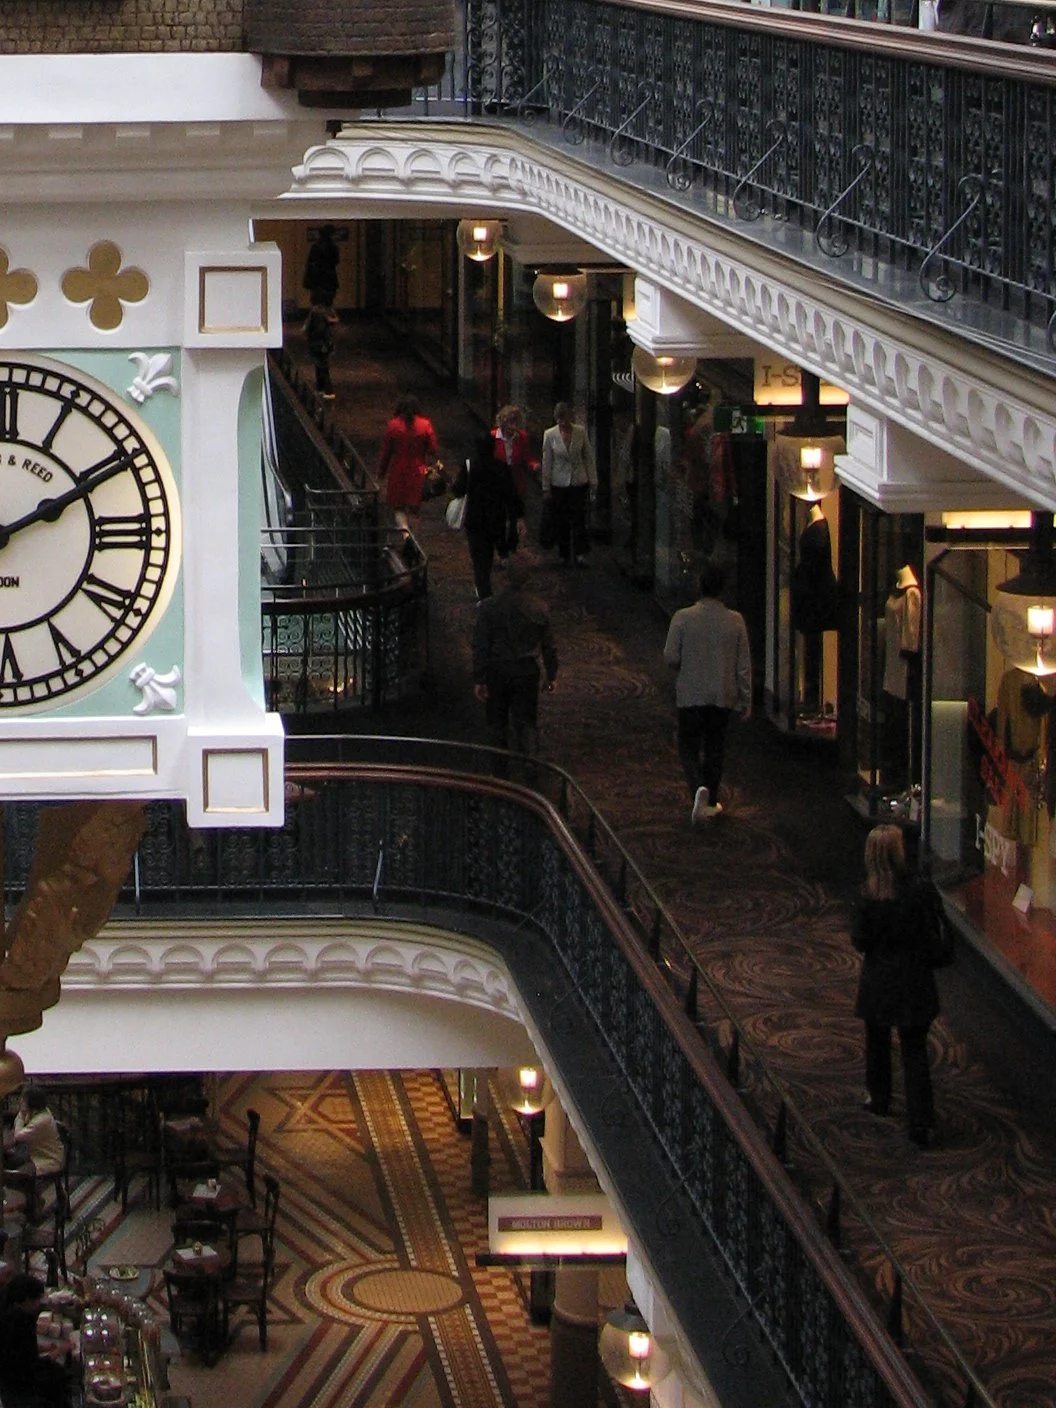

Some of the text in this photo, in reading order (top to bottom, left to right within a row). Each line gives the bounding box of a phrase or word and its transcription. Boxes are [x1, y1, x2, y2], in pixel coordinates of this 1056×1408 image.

[42, 401, 72, 451] I
[7, 455, 17, 466] &
[22, 457, 53, 483] REED
[94, 514, 147, 552] III
[79, 573, 134, 622] IV
[47, 619, 81, 667] V
